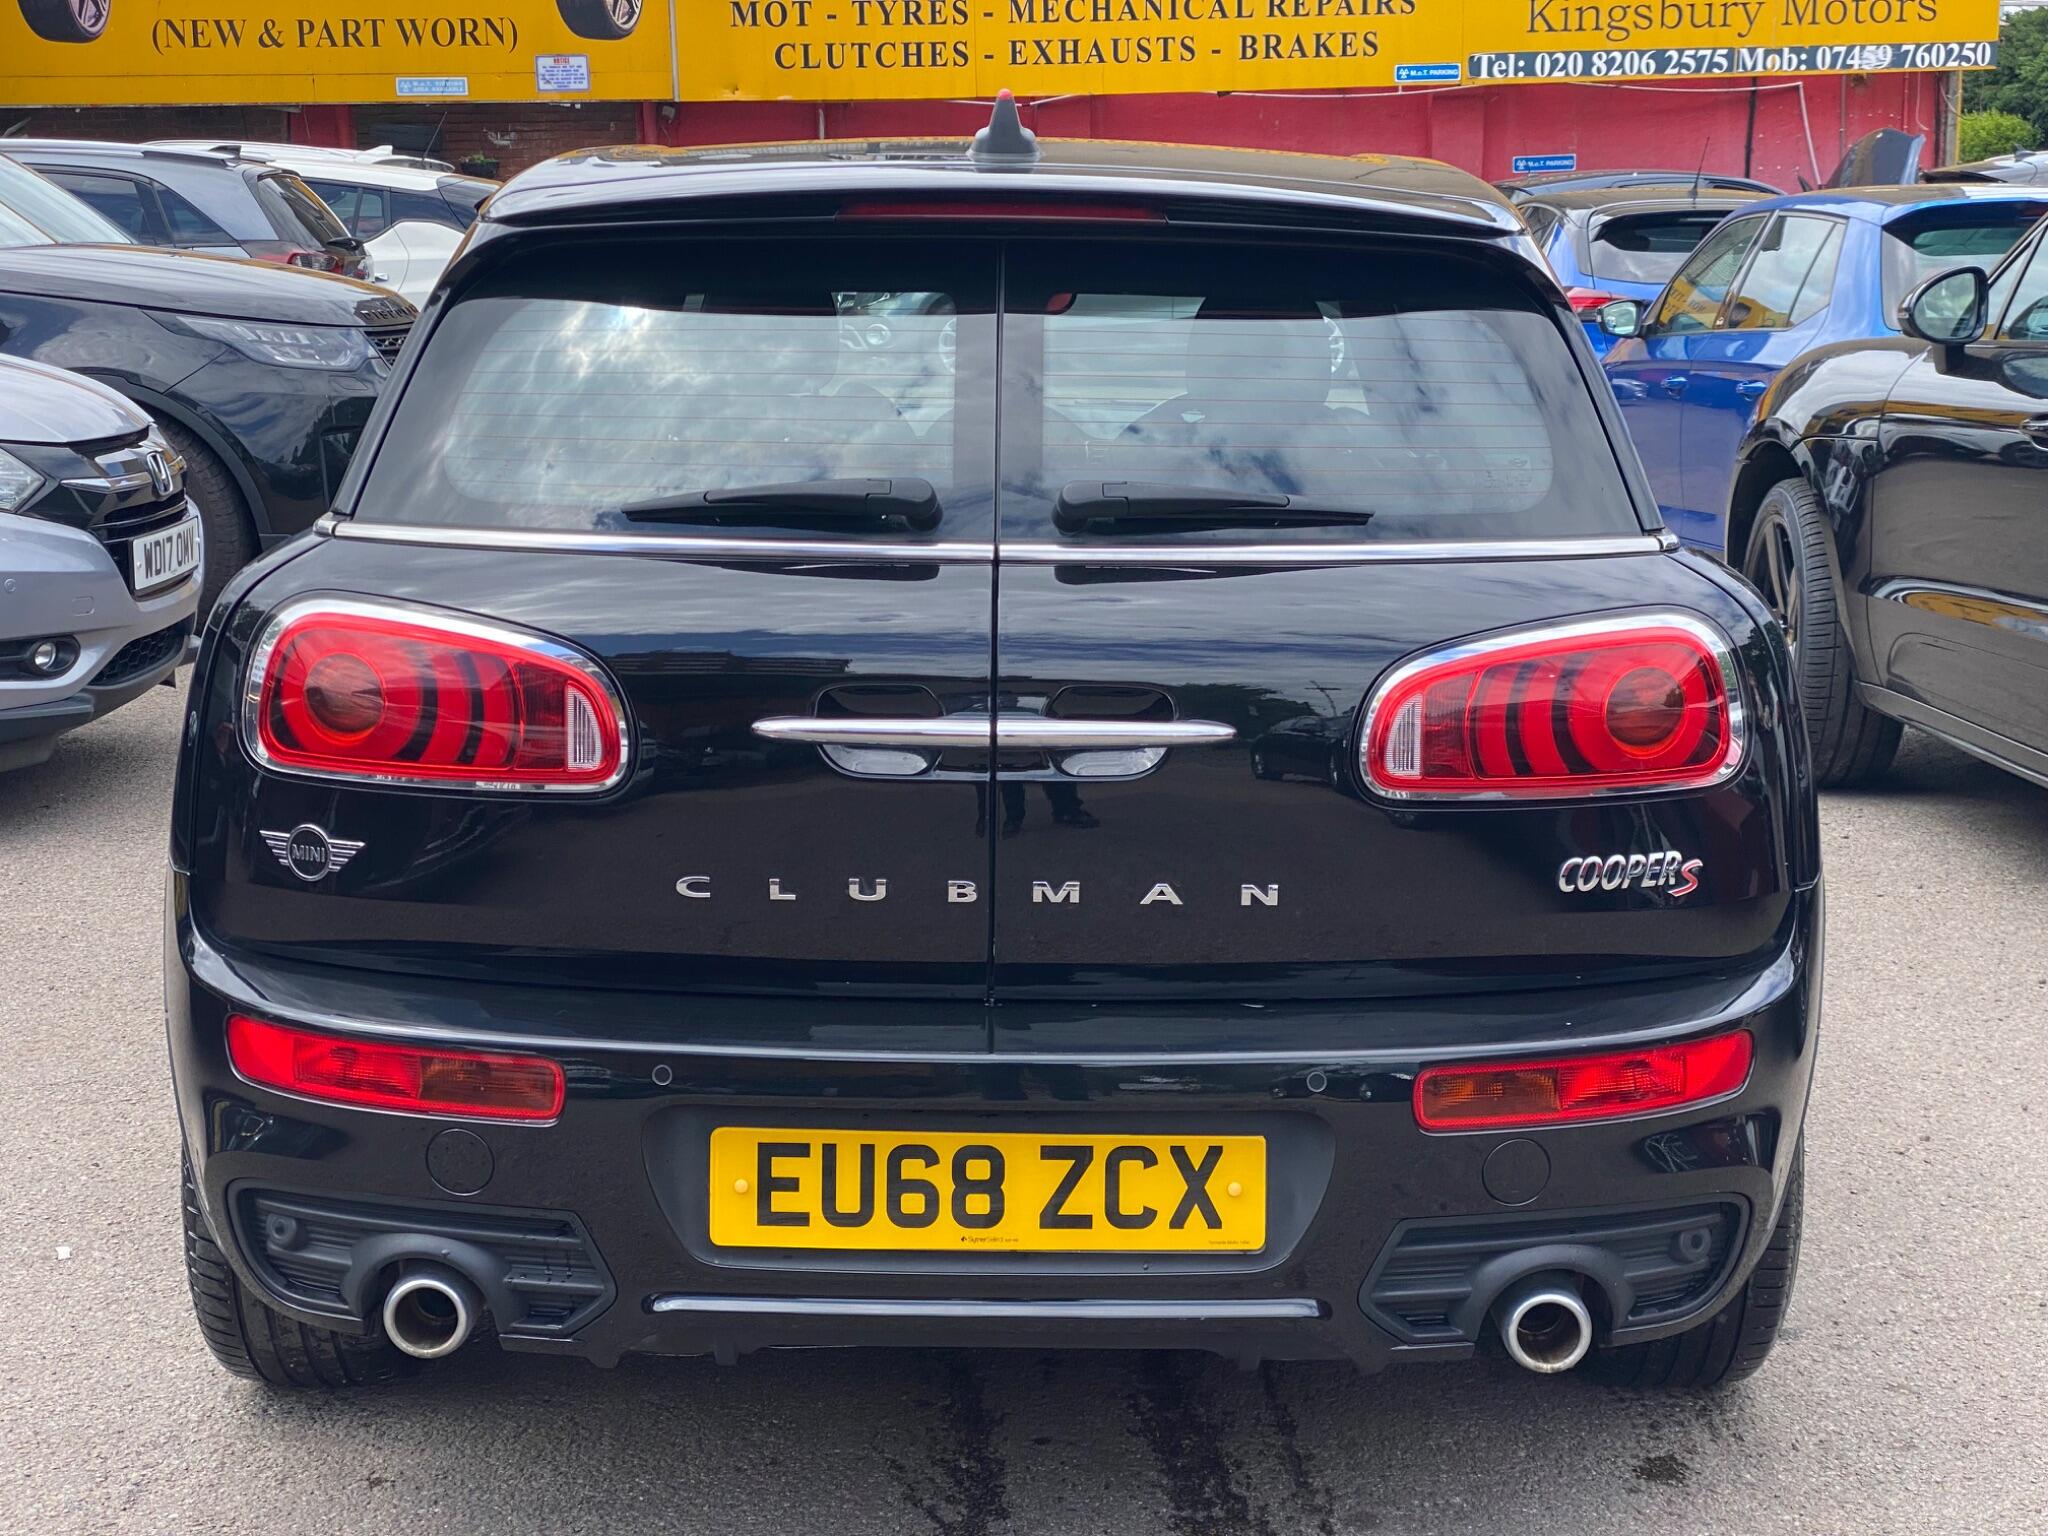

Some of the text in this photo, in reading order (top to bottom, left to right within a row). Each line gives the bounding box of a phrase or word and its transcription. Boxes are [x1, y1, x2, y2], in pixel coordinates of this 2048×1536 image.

[729, 0, 812, 28] MOT
[852, 0, 969, 26] TYRES
[1008, 0, 1254, 25] MECHANICAL
[1266, 0, 1416, 18] REPAIRS
[1526, 0, 1938, 42] Kingsbury Motors
[151, 16, 519, 55] (NEW & PART WORN)
[774, 40, 969, 70] CLUTCHES
[1008, 35, 1197, 65] EXHAUSTS
[1238, 31, 1380, 61] BRAKES
[1473, 48, 1730, 79] Tel: 020 8206 2575
[1737, 47, 1808, 73] Mob:
[1900, 42, 1991, 69] 760250
[292, 843, 326, 862] MINI
[1559, 851, 1682, 892] COOPER
[675, 875, 1279, 906] CLUBMAN
[756, 1142, 1223, 1230] EU68 ZCX
